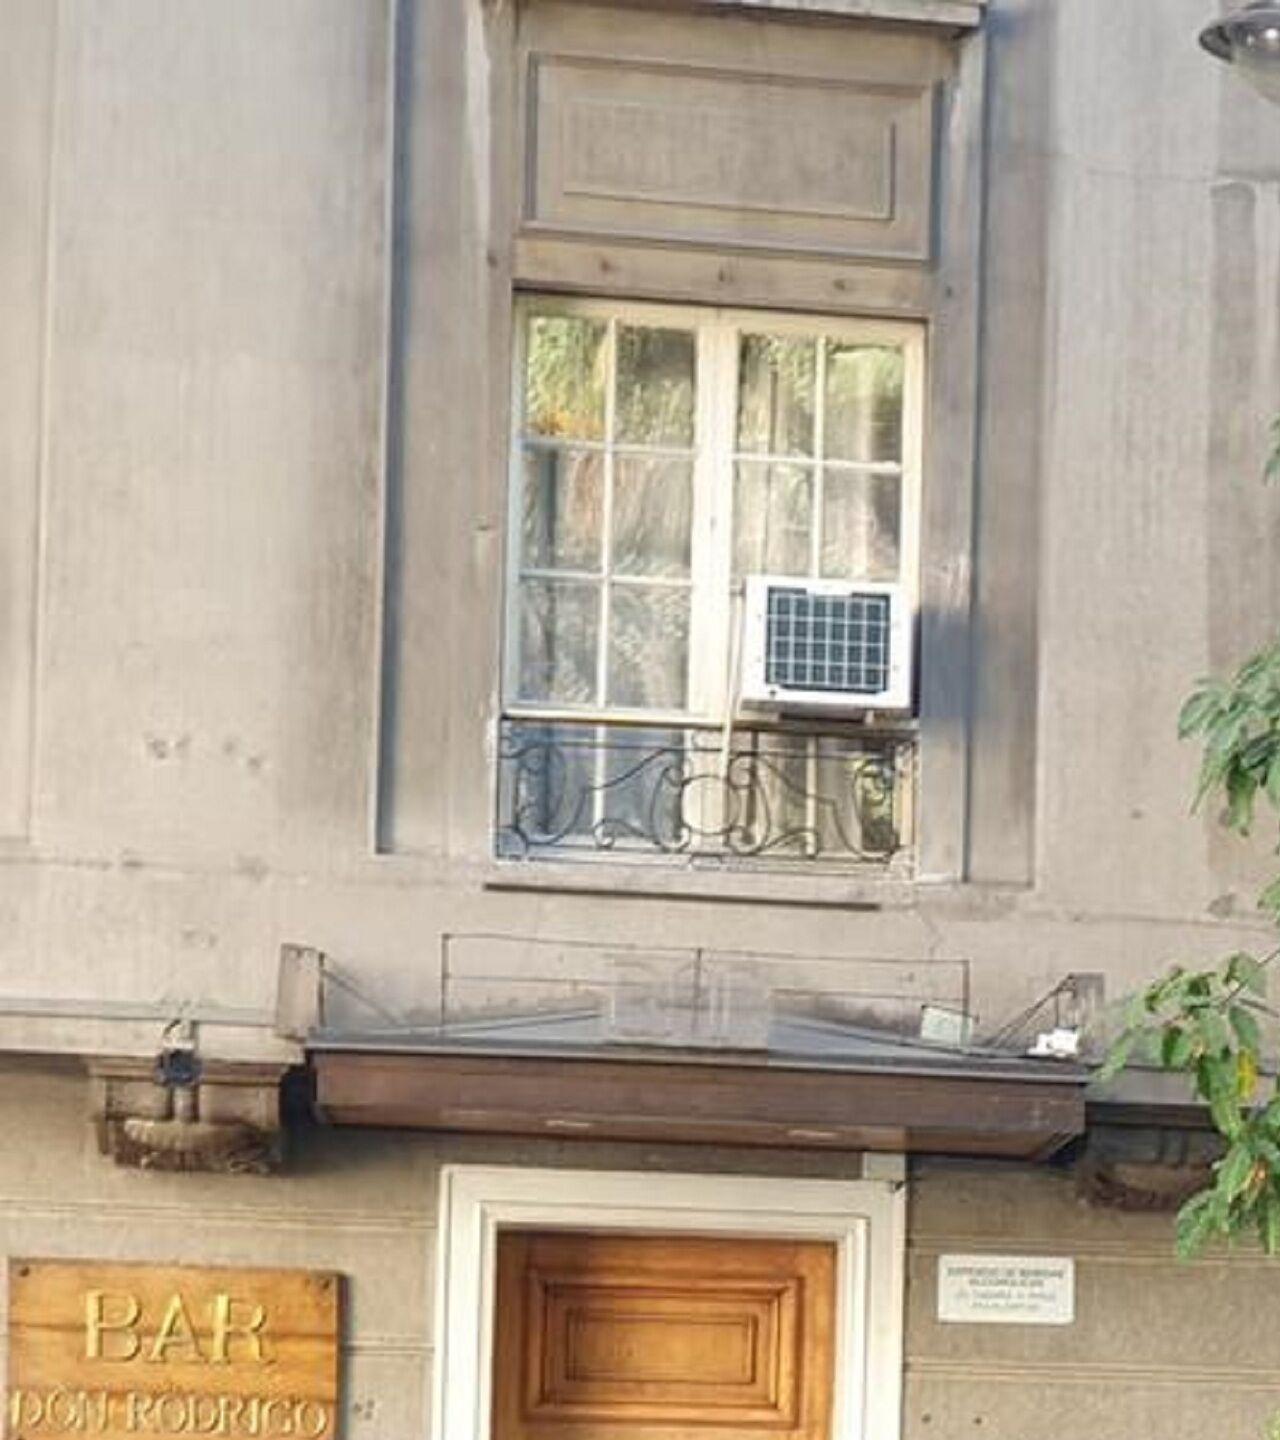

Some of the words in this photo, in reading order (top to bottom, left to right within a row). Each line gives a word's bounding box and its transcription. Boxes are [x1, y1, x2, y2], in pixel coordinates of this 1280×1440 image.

[84, 1287, 276, 1364] BAR
[10, 1389, 108, 1430] DON
[126, 1390, 328, 1439] RODRIGO
